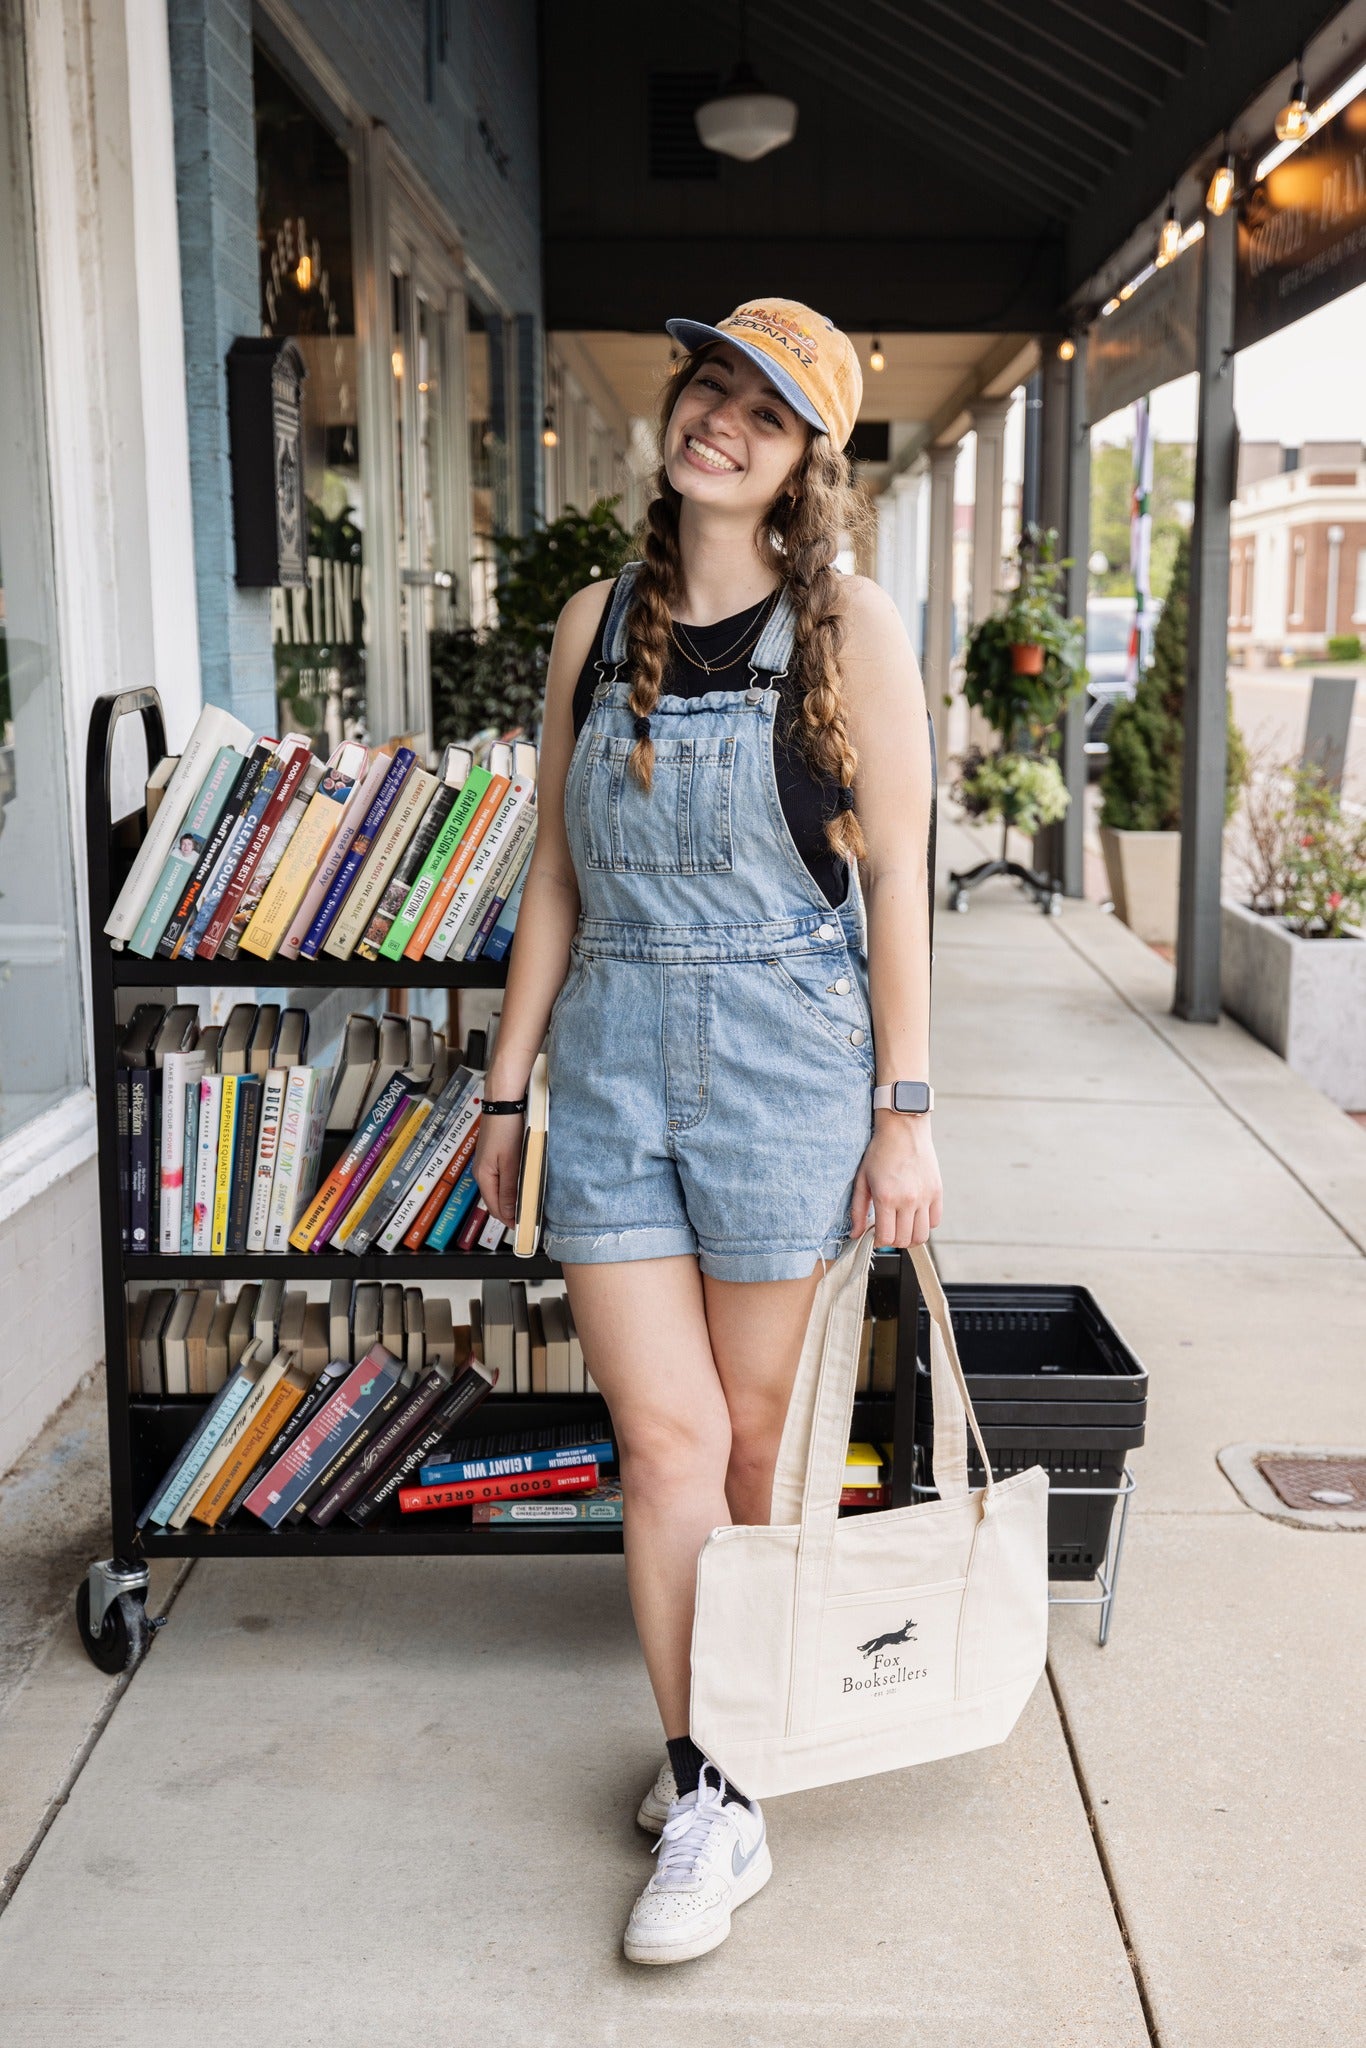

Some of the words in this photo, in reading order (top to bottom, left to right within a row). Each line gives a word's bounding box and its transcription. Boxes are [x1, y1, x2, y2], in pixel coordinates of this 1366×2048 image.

[208, 755, 231, 791] JAMIE
[407, 778, 428, 806] CARROTS
[191, 790, 215, 830] OLIVER
[398, 805, 413, 823] LOVE
[451, 788, 477, 826] GRAPHIC
[481, 808, 489, 818] THE
[493, 796, 517, 833] Daniel
[216, 812, 234, 837] Staff
[232, 813, 258, 855] CLEAN
[255, 823, 270, 842] BEST
[336, 826, 355, 850] Rosé
[471, 818, 484, 835] SALES
[250, 841, 262, 853] OF
[381, 822, 405, 855] TOMATOES
[436, 824, 459, 856] DESIGN
[485, 833, 498, 847] H.
[496, 824, 525, 868] Rationality
[195, 835, 222, 882] Favorites
[244, 850, 257, 866] THE
[328, 850, 342, 866] All
[430, 854, 443, 870] FOR
[452, 834, 476, 873] ACCELERATION
[472, 848, 490, 873] Pink
[163, 861, 183, 893] jamie's
[211, 856, 237, 898] SOUPS
[236, 864, 251, 883] BEST
[316, 866, 334, 887] Day
[369, 860, 385, 881] ROSES
[361, 880, 375, 897] LOVE
[439, 872, 456, 897] FORMULA
[149, 892, 170, 925] dinners
[176, 880, 201, 919] Potluck
[349, 896, 367, 920] GARLIC
[404, 879, 431, 918] EVERYONE
[444, 890, 468, 928] WHEN
[467, 884, 494, 927] Relativism
[263, 1086, 281, 1122] BUCK
[287, 1076, 305, 1109] ONLY
[368, 1078, 403, 1126] NIGHTS
[132, 1083, 143, 1135] Self-Realization
[222, 1097, 231, 1142] HAPPINESS
[245, 1103, 254, 1136] RIVER
[365, 1122, 375, 1132] in
[447, 1108, 473, 1143] Daniel
[259, 1125, 276, 1159] WILD
[352, 1130, 370, 1155] White
[371, 1135, 385, 1153] LOVE
[439, 1143, 451, 1156] H.
[460, 1135, 476, 1155] GOD
[219, 1144, 228, 1186] EQUATION
[241, 1148, 250, 1182] DOUBT
[278, 1141, 295, 1176] TODAY
[338, 1152, 356, 1176] Castle
[349, 1152, 374, 1188] LANGUAGES
[424, 1156, 442, 1179] Pink
[447, 1153, 465, 1178] SHOT
[199, 1191, 205, 1199] OF
[260, 1184, 268, 1219] STEPHEN
[275, 1183, 288, 1216] STAFFORD
[320, 1185, 336, 1206] Steve
[451, 1174, 473, 1205] Mitch
[304, 1204, 325, 1232] Rushin
[392, 1197, 415, 1228] WHEN
[434, 1203, 458, 1238] Albom
[267, 1383, 294, 1416] Times
[422, 1388, 431, 1398] THE
[217, 1393, 242, 1430] SYLVIA
[259, 1412, 275, 1430] and
[331, 1402, 348, 1418] Father
[396, 1394, 425, 1427] PURPOSE
[199, 1439, 214, 1459] SEA
[238, 1426, 265, 1459] Places
[343, 1427, 369, 1458] CHASING
[375, 1422, 401, 1452] DRIVEN
[421, 1428, 442, 1451] The
[295, 1445, 312, 1461] Father
[398, 1445, 426, 1476] Right
[487, 1457, 523, 1475] GIANT
[523, 1456, 533, 1469] A
[548, 1455, 580, 1467] COUGHLIN
[581, 1453, 596, 1463] TOM
[228, 1460, 243, 1478] BASIC
[318, 1454, 346, 1487] DAYLIGHT
[339, 1469, 360, 1493] WARREN
[462, 1462, 486, 1479] WIN
[557, 1476, 579, 1485] COLLINS
[168, 1461, 199, 1507] CHANGE
[210, 1477, 232, 1506] READERS
[372, 1470, 404, 1506] Nation
[424, 1488, 474, 1505] GREAT
[481, 1485, 501, 1497] TO
[509, 1478, 551, 1493] GOOD
[873, 1654, 900, 1670] Fox
[842, 1667, 928, 1693] Booksellers
